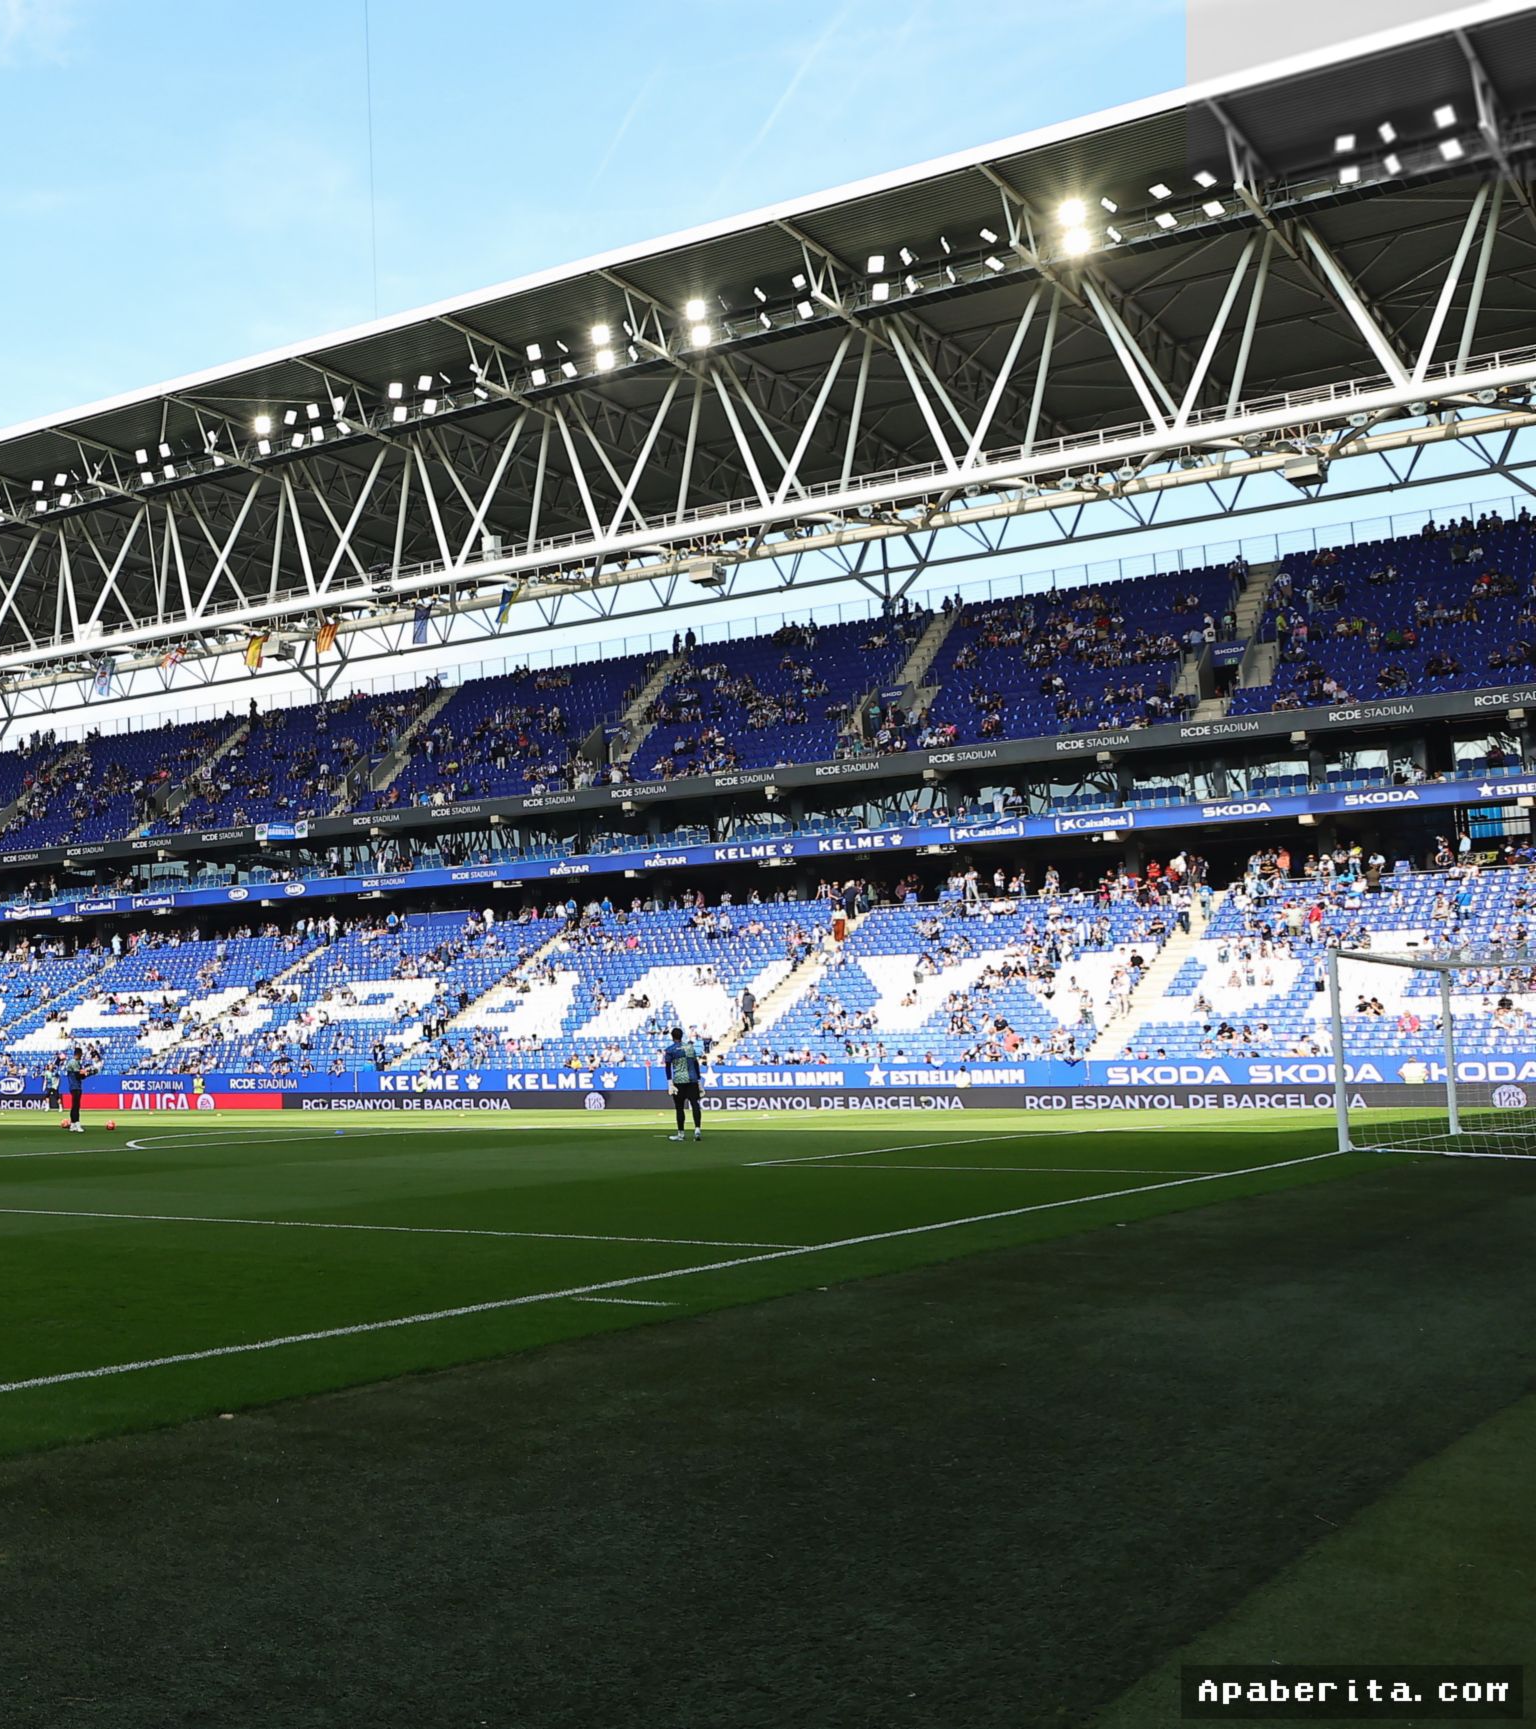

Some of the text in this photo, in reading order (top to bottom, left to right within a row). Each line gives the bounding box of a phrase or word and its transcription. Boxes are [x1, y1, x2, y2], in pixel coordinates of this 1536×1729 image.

[1474, 694, 1510, 706] RCDE
[1329, 704, 1414, 722] RCDE STADIUM
[1180, 720, 1259, 738] RCDE STADIUM
[1056, 736, 1130, 751] RCDE STADIUM
[929, 750, 996, 764] RCDE STADIUM
[816, 762, 879, 776] RCDE STADIUM
[715, 772, 774, 786] RCDE STADIUM
[611, 786, 666, 798] RCDE STADIUM
[1344, 790, 1419, 805] SKODA
[523, 796, 576, 808] RCDE STADIUM
[432, 805, 480, 817] RCDE STADIUM
[1203, 802, 1271, 818] SKODA
[353, 814, 400, 826] RCDE STADIUM
[1077, 816, 1127, 829] CaixaBank
[202, 831, 243, 842] RCDE STADIUM
[970, 826, 1018, 837] CaixaBank
[818, 836, 884, 850] KELME
[715, 845, 776, 860] KELME
[645, 856, 686, 867] RASTAR
[452, 870, 497, 880] RCDE STADIUM
[550, 864, 589, 875] RASTAR
[380, 876, 405, 886] STADIUM
[380, 1075, 459, 1090] KELME
[507, 1073, 594, 1090] KELME
[722, 1072, 843, 1086] ESTRELLA DAMM
[971, 1070, 1025, 1084] DAMM
[1107, 1066, 1231, 1085] SKODA
[122, 1080, 146, 1090] RCDE
[230, 1079, 297, 1089] RCDE STADIUM
[302, 1098, 511, 1110] RCD ESPANYOL DE BARCELONA
[688, 1096, 964, 1110] CD ESPANYOL DE BARCELONA
[1025, 1093, 1368, 1110] RCD ESPANYOL DE BARCELOA
